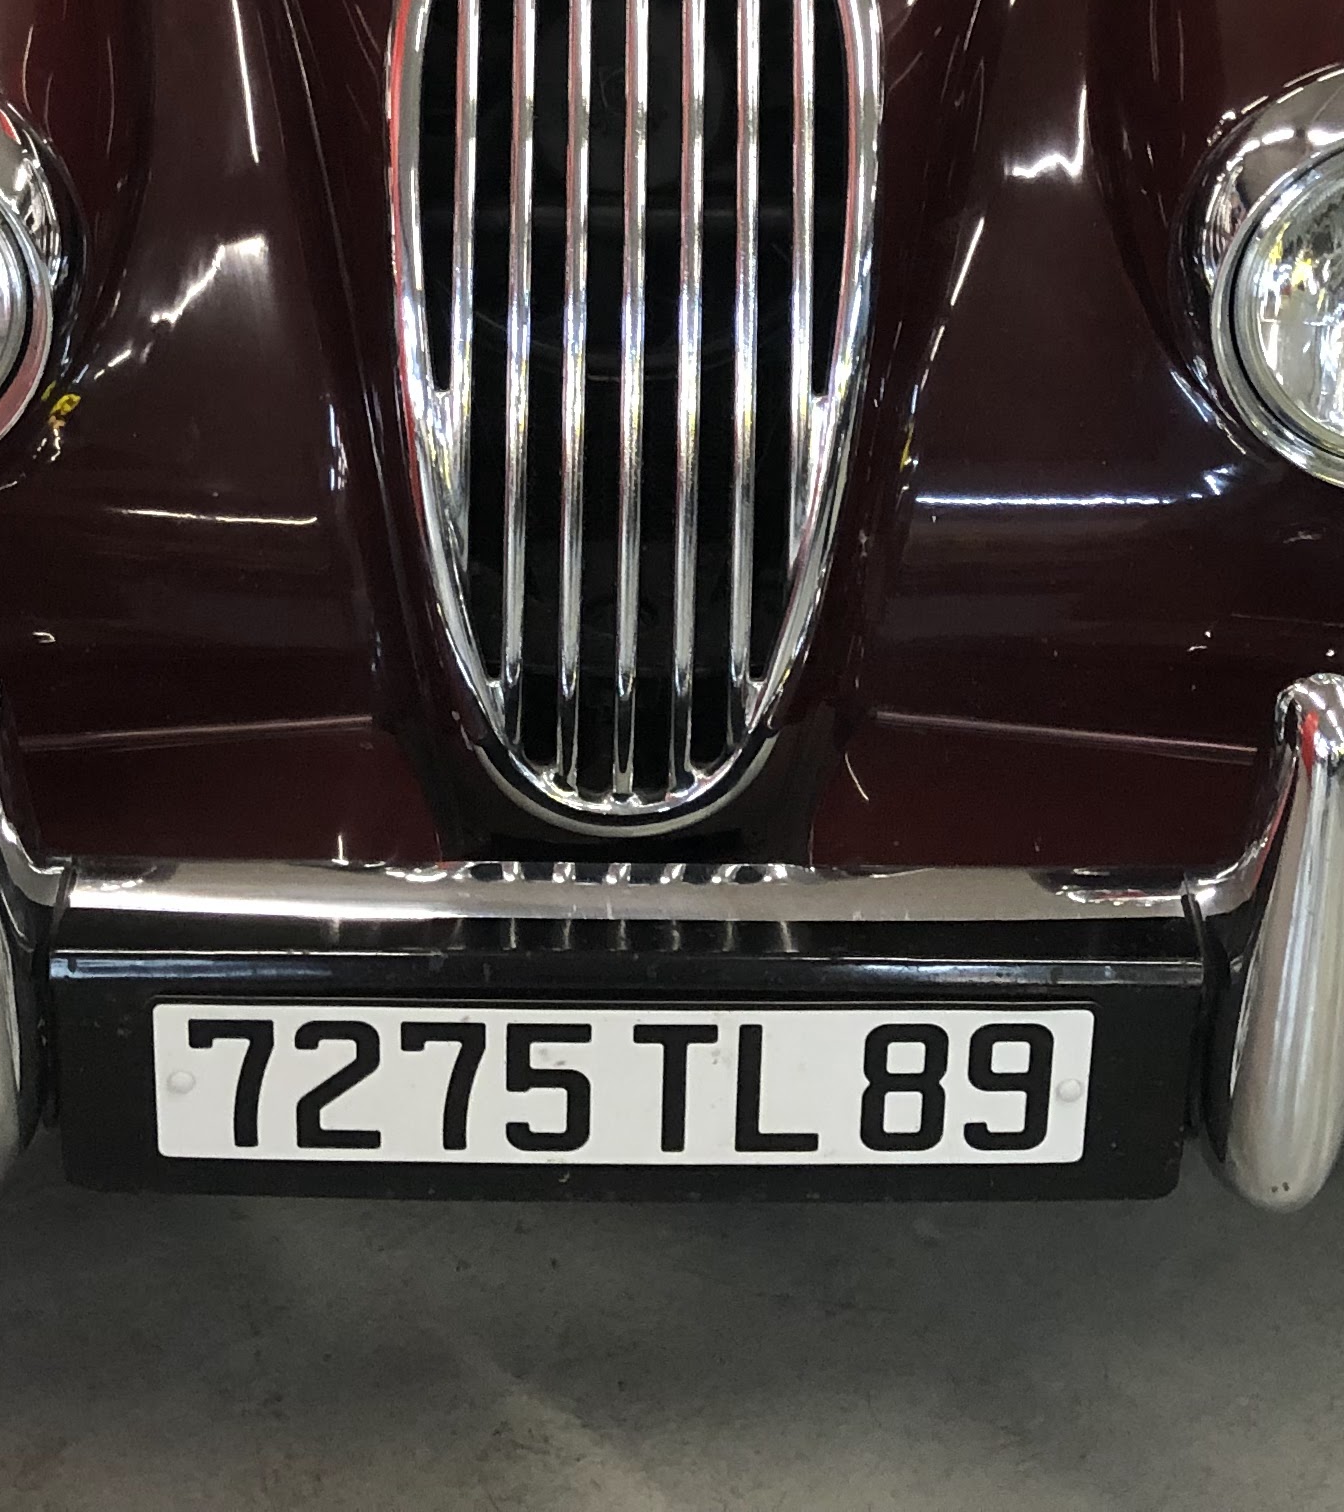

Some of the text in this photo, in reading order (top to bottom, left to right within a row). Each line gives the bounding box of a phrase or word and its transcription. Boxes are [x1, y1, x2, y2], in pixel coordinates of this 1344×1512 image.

[188, 1018, 1055, 1153] 7275 TL 89
